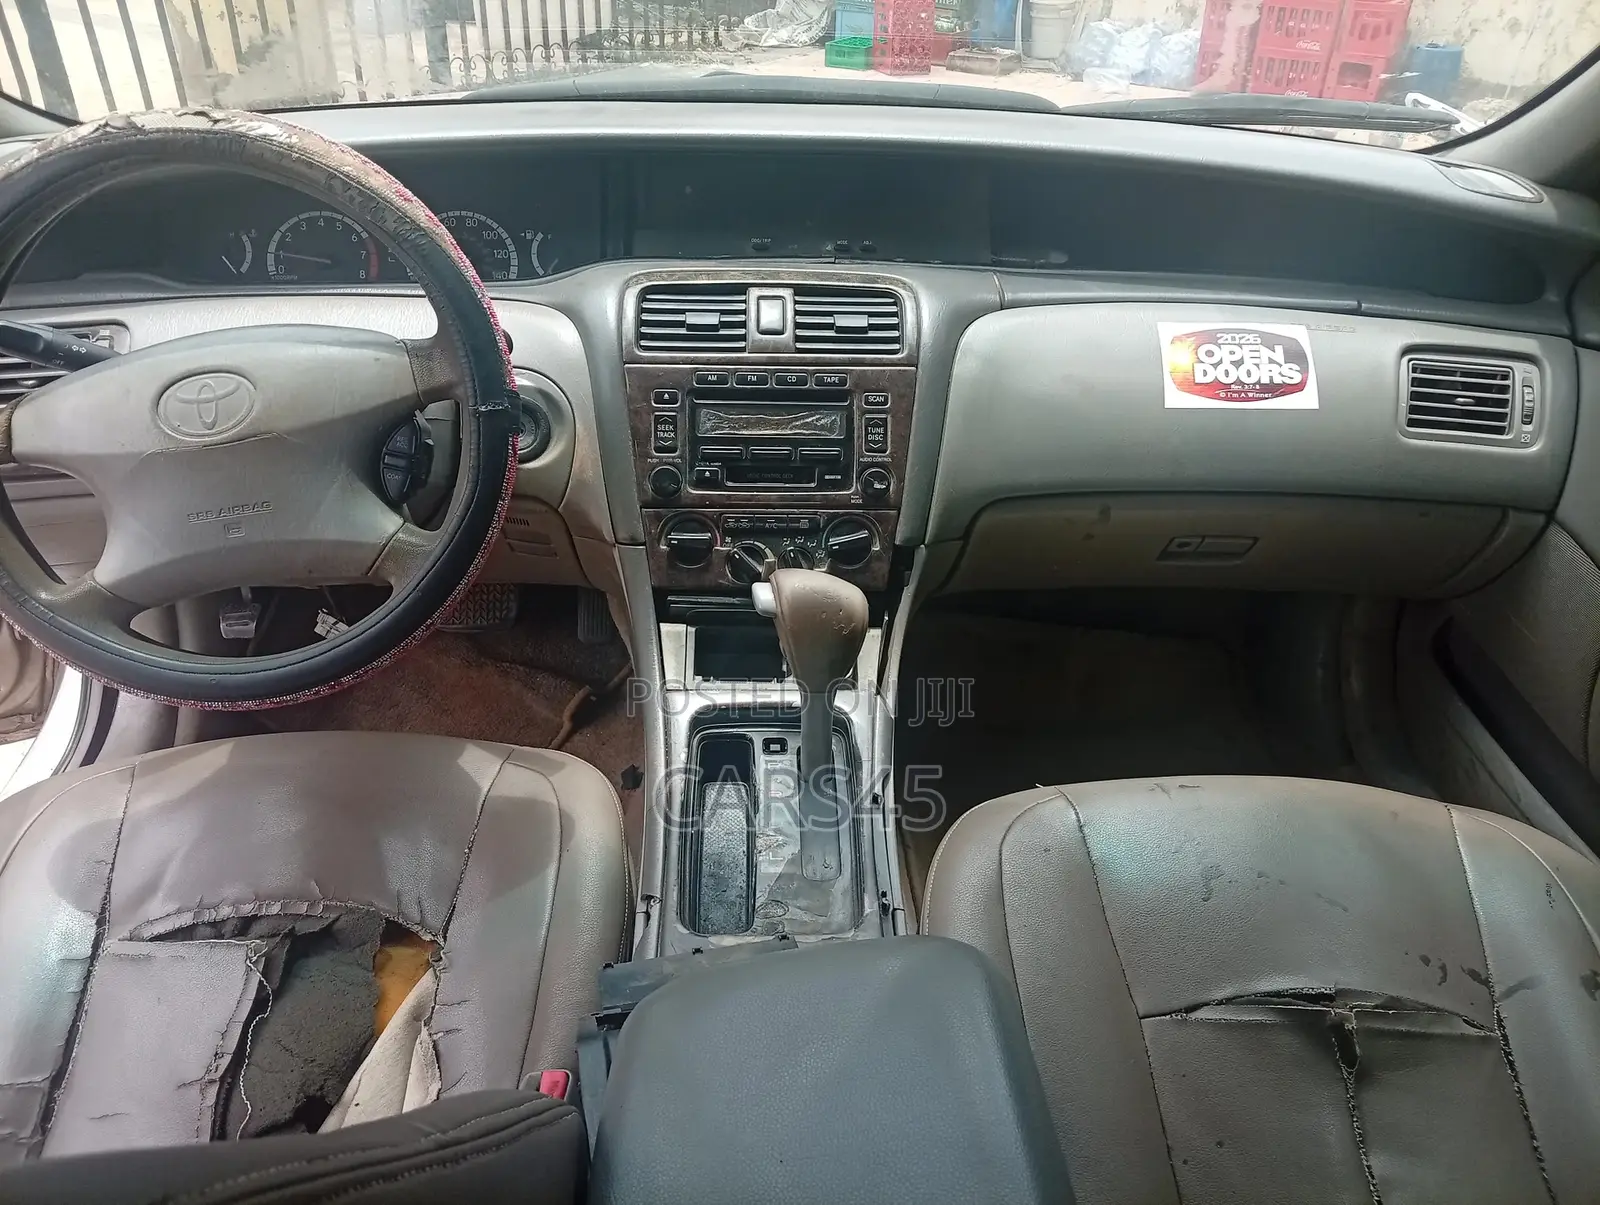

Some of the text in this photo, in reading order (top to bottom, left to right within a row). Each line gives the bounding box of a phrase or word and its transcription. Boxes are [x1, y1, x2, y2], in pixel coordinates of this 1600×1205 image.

[300, 222, 307, 231] 3
[317, 218, 324, 227] 4
[336, 222, 342, 231] 5
[465, 218, 478, 227] 80
[285, 232, 292, 242] 2
[351, 233, 358, 242] 6
[482, 230, 499, 240] 100
[360, 250, 366, 259] 7
[493, 249, 509, 259] 120
[278, 265, 285, 274] 0
[359, 269, 366, 279] 8
[1216, 333, 1261, 344] 2026
[1197, 344, 1285, 365] OPEN
[1194, 363, 1302, 384] DOORS
[187, 501, 273, 521] SRS AIRBAG
